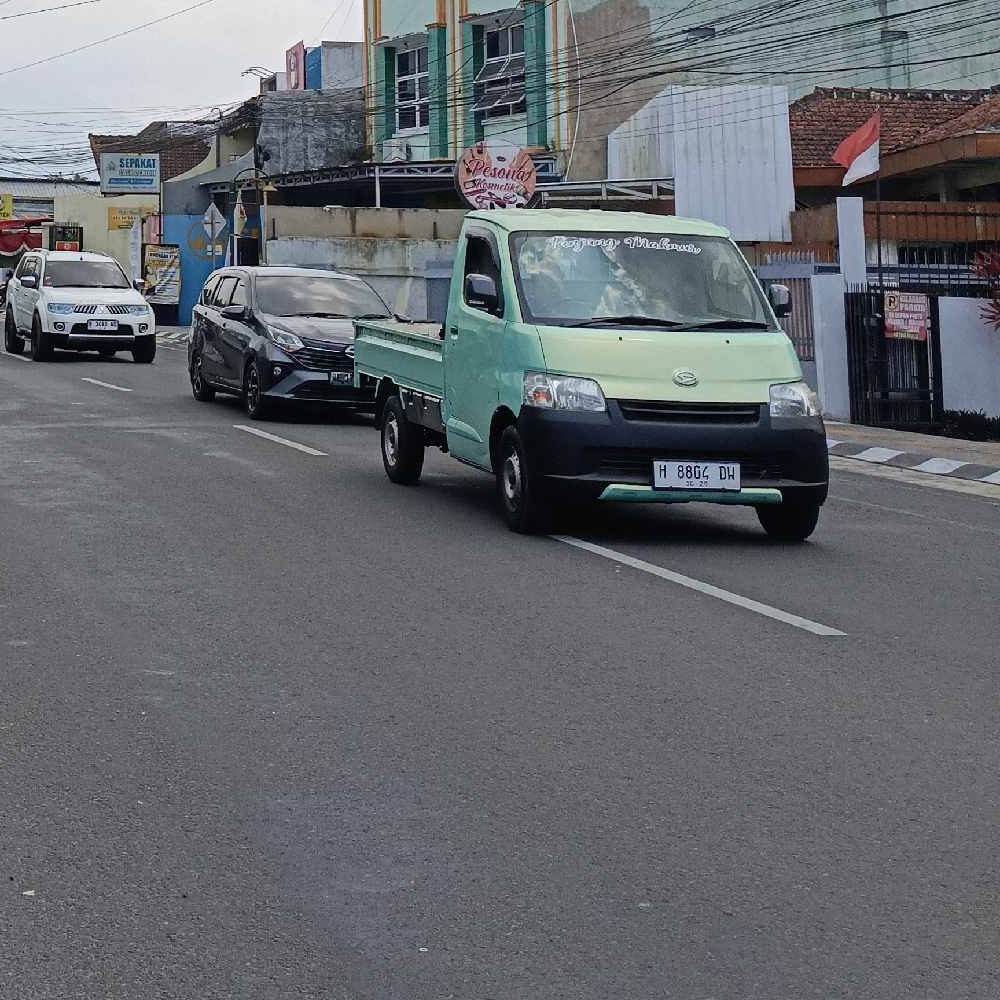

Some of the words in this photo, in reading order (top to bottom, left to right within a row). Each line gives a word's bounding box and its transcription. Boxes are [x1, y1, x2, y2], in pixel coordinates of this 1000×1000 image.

[120, 158, 156, 168] SEPAKAT
[469, 158, 533, 182] Pesona
[474, 178, 516, 193] Kosmetik
[659, 464, 667, 478] H
[677, 465, 709, 480] 8804
[719, 466, 735, 480] DW
